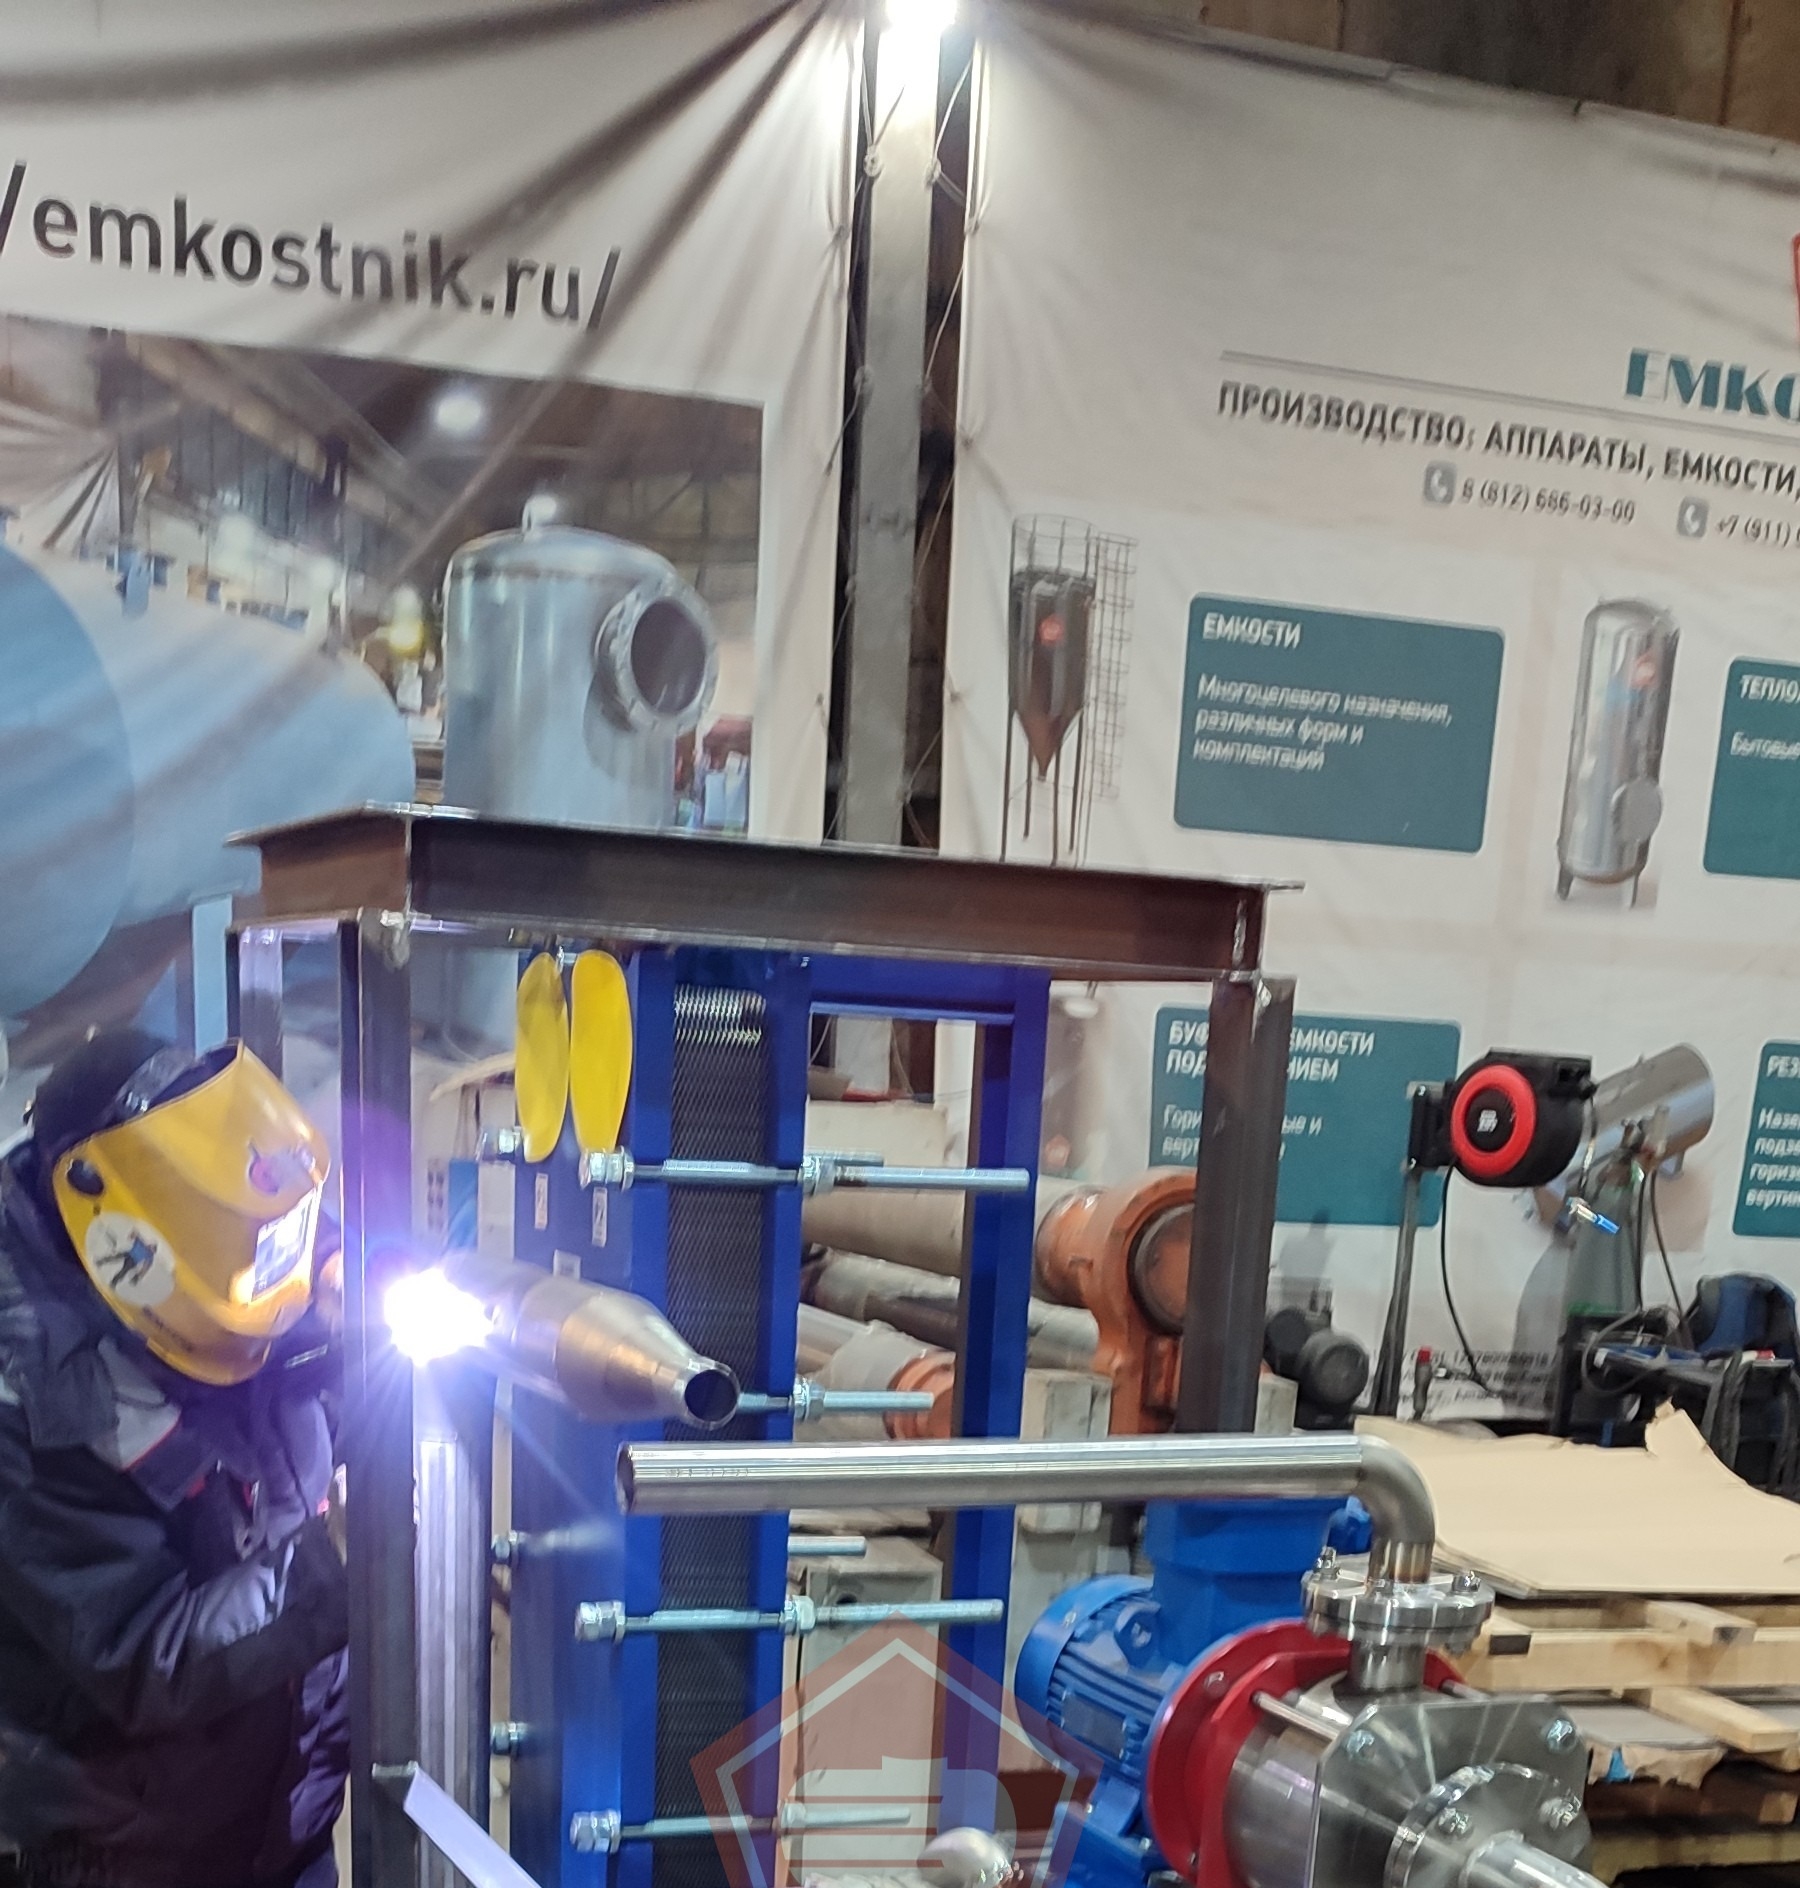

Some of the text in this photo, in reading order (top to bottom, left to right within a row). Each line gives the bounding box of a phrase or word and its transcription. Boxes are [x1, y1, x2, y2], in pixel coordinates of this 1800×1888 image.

[1218, 380, 1476, 450] ПРОИЗВОДСТВО:
[1484, 421, 1655, 482] АППАРАТЫ,
[1480, 479, 1530, 512] (812)
[1744, 516, 1790, 548] (911)
[1202, 611, 1301, 649] ЕМКОСТИ
[1197, 673, 1453, 727] Многоцелевого назначения,
[1739, 674, 1800, 704] ТЕПЛО
[1194, 709, 1364, 750] различных форм и
[1193, 738, 1325, 772] комплектаций
